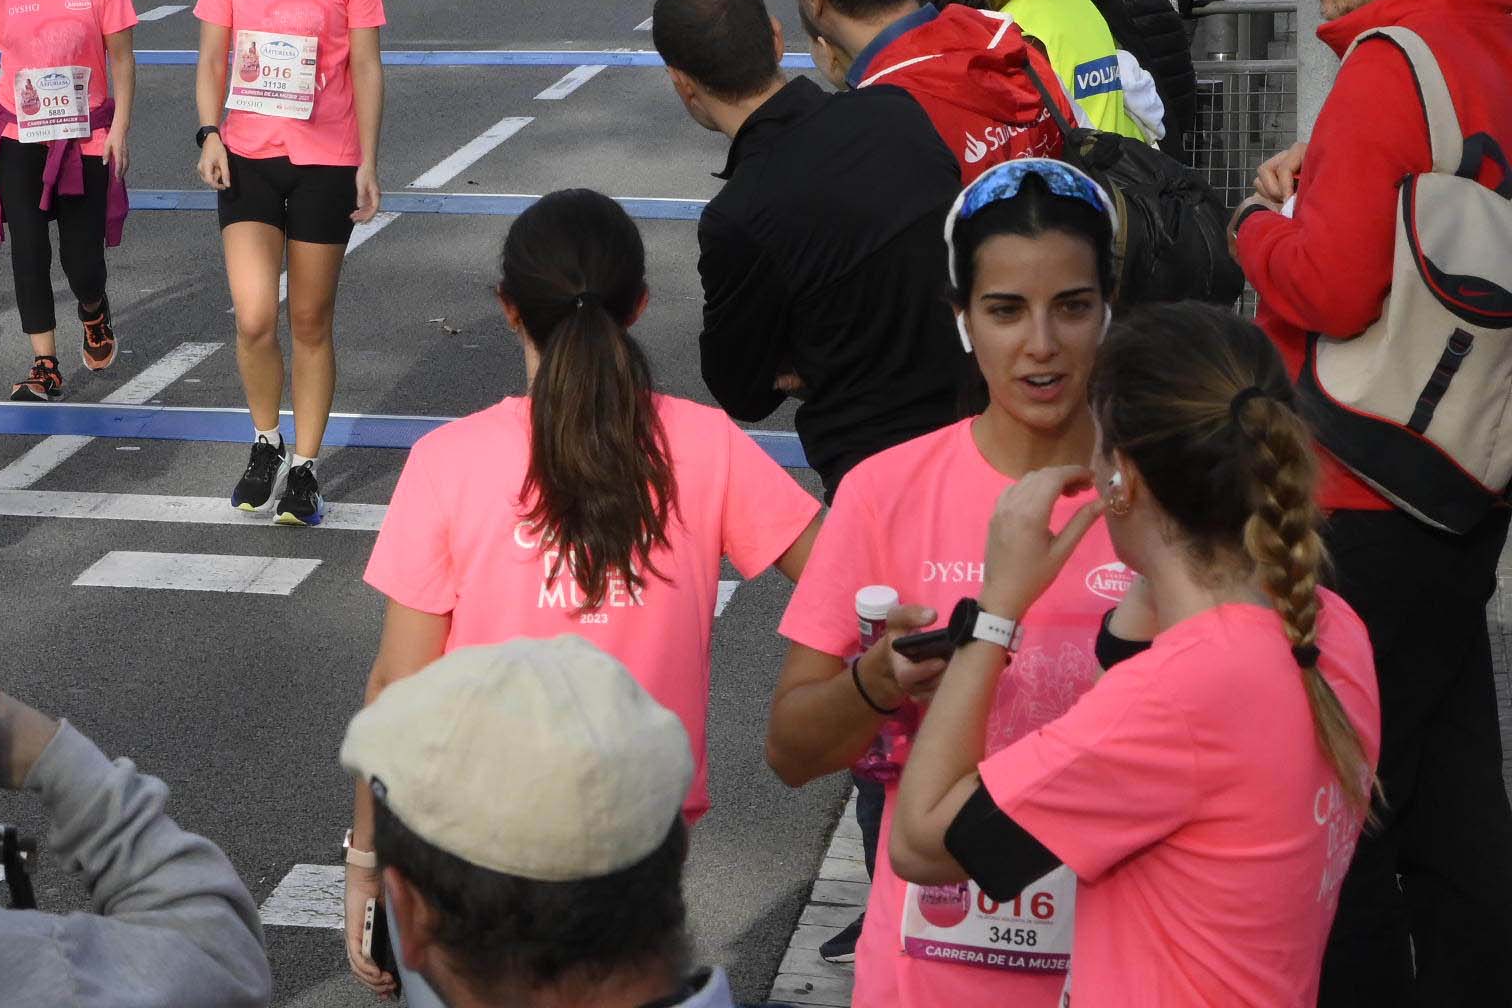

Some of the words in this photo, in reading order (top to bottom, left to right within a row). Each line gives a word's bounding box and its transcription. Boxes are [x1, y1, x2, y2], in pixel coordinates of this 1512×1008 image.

[261, 65, 293, 80] 016
[42, 95, 70, 108] 016
[579, 613, 609, 625] 2023
[988, 926, 1038, 947] 3458
[925, 945, 985, 964] CARRERA
[987, 953, 1006, 966] DE
[1008, 956, 1026, 968] LA
